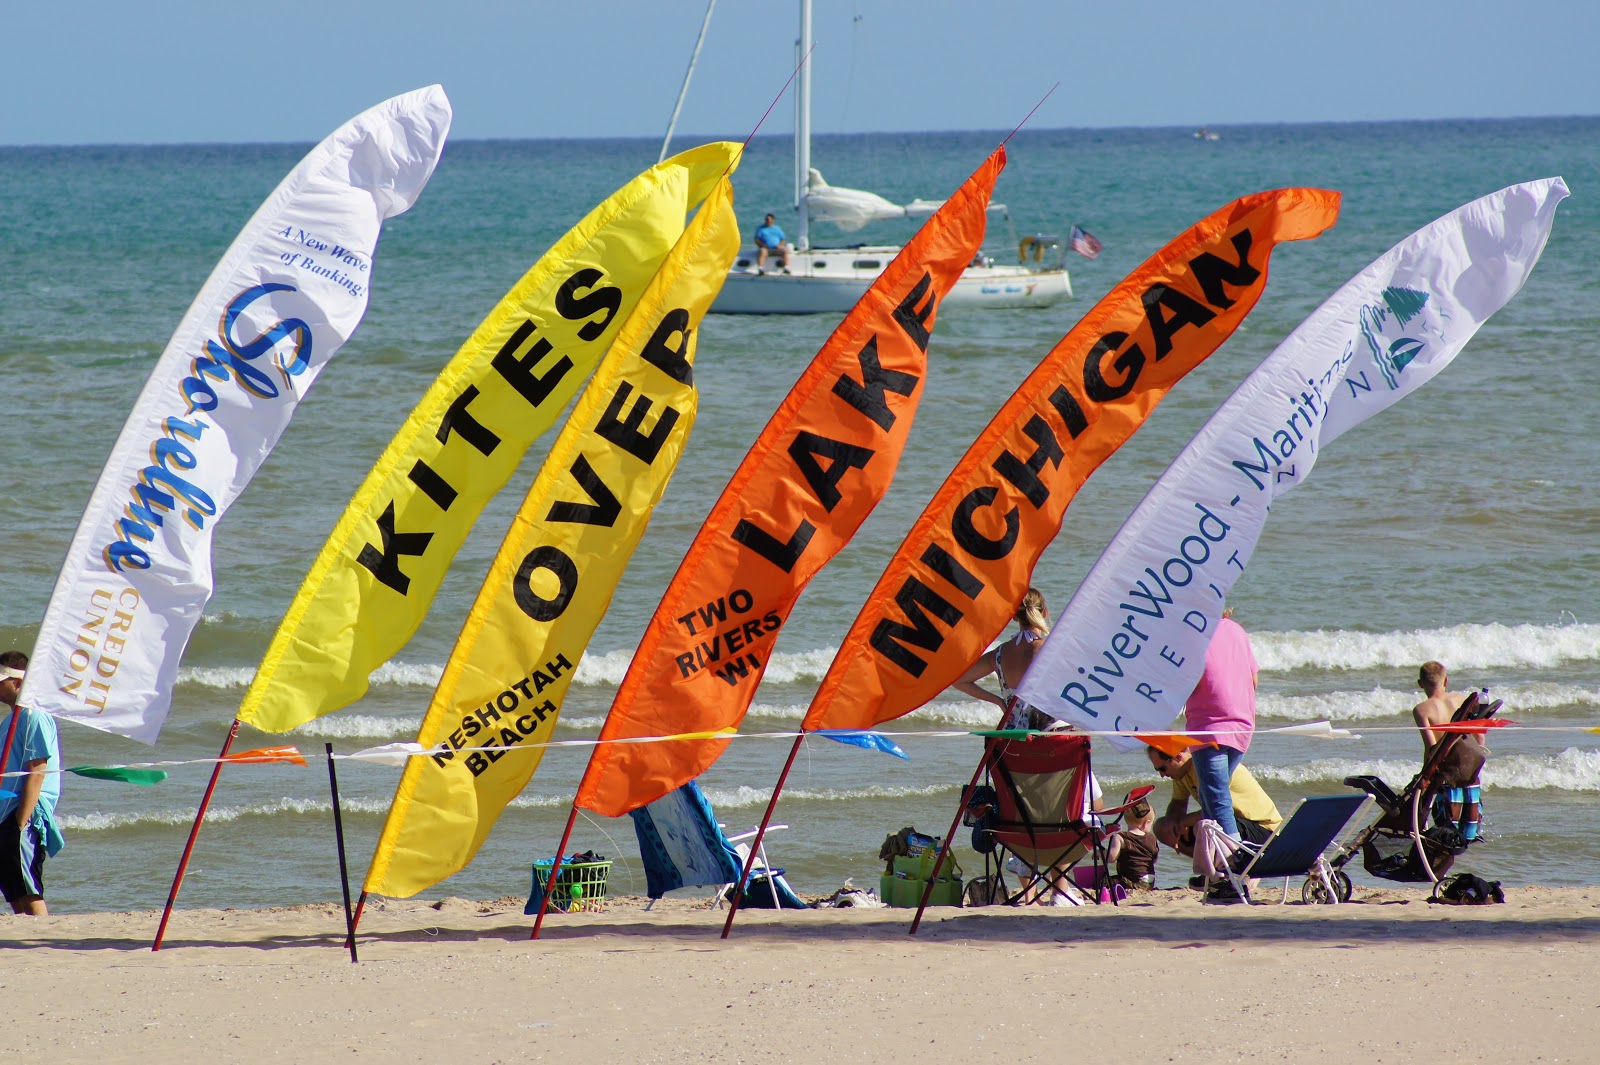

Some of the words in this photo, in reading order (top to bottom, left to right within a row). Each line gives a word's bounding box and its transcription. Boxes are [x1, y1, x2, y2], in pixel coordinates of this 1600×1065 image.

[278, 226, 292, 238] A
[293, 228, 328, 252] New
[330, 244, 368, 272] Wave
[280, 252, 302, 266] of
[300, 257, 367, 297] Banking!
[102, 282, 313, 574] Shoreline
[356, 268, 623, 597] KITES
[869, 228, 1261, 679] MICHIGAN
[58, 588, 113, 699] UNION
[84, 587, 140, 715] CREDIT
[674, 609, 782, 679] RIVERS
[677, 589, 754, 637] TWO
[1060, 502, 1232, 719] RiverWood
[432, 653, 573, 769] NESHOTAH
[715, 653, 761, 687] WI
[464, 699, 557, 778] BEACH
